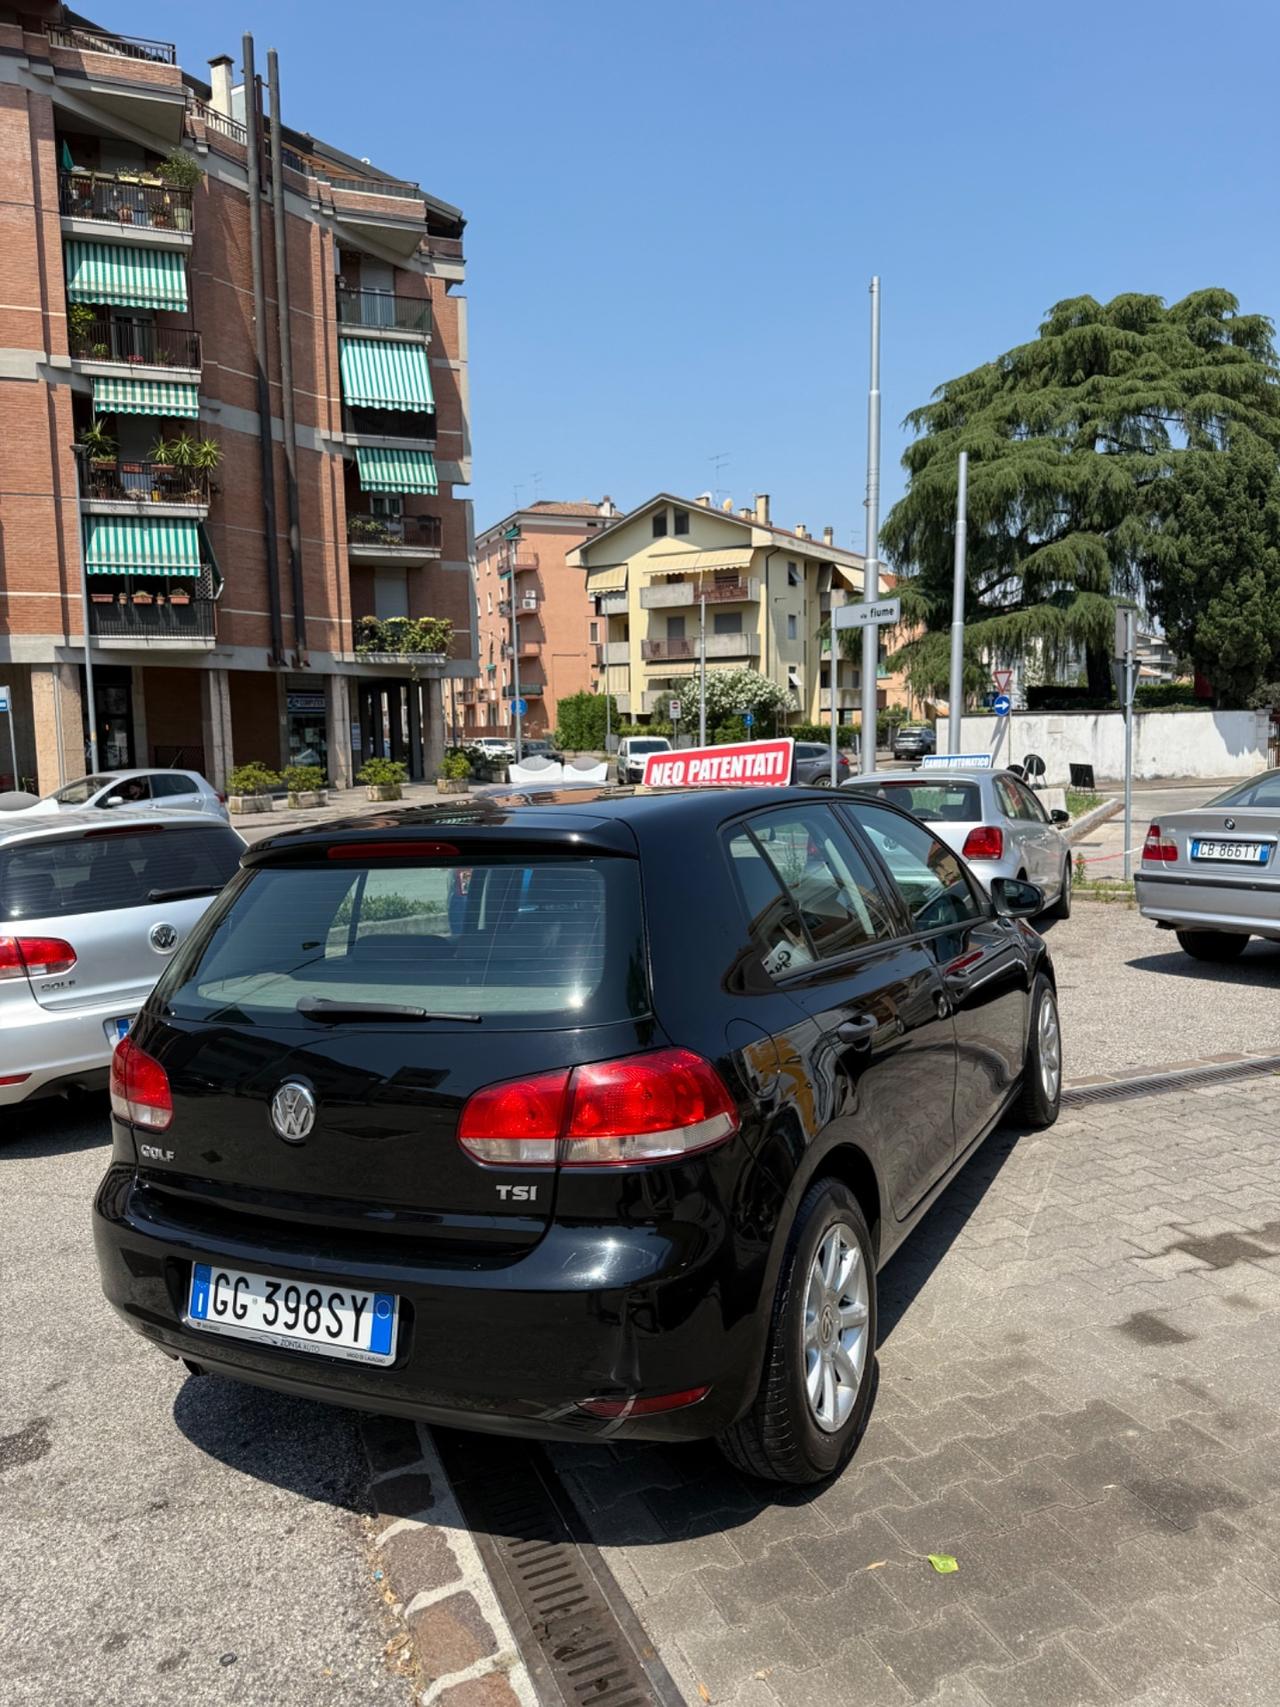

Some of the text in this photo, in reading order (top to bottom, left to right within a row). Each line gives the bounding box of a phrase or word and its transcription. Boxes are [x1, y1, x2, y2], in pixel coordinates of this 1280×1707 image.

[870, 607, 894, 618] fiume
[650, 751, 784, 785] NEO PATENTATI
[1200, 842, 1259, 858] CB 866TY
[140, 1144, 175, 1162] GOLF
[495, 1184, 538, 1200] TSI
[213, 1272, 369, 1343] GG 398SY
[303, 1342, 320, 1353] AUTO
